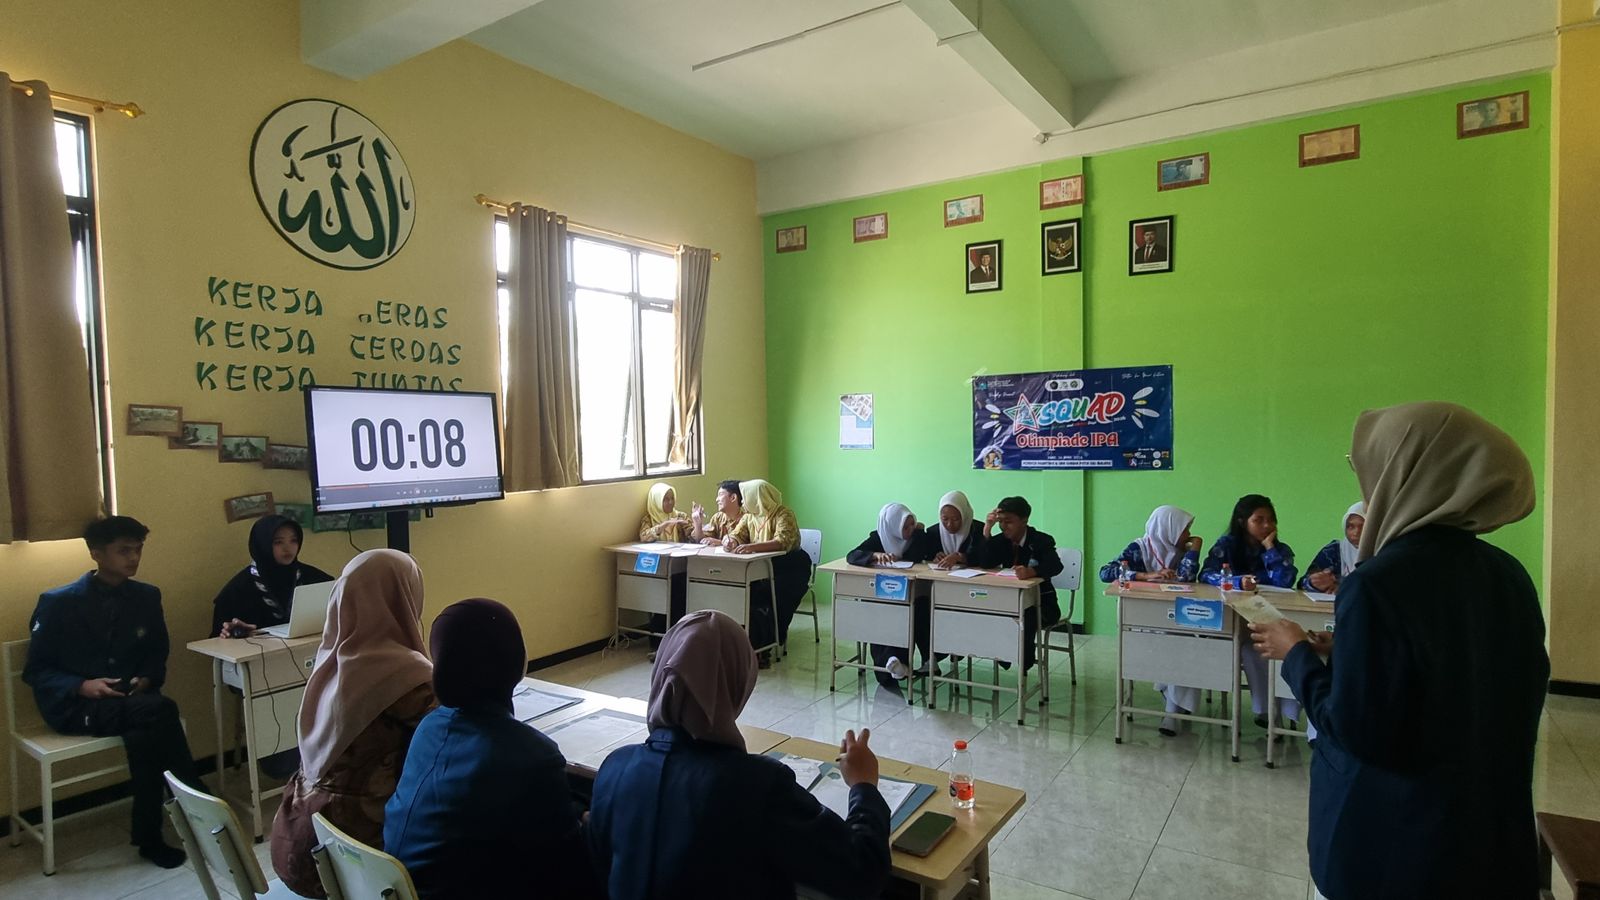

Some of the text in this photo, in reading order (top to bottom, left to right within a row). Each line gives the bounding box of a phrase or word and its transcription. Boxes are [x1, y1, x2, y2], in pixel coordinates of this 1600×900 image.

[208, 276, 323, 316] KERJA
[194, 316, 462, 366] KERJA CERDAS
[196, 361, 318, 392] KERJA
[351, 417, 467, 471] 00:08
[1016, 431, 1119, 450] Olimpiade IPA
